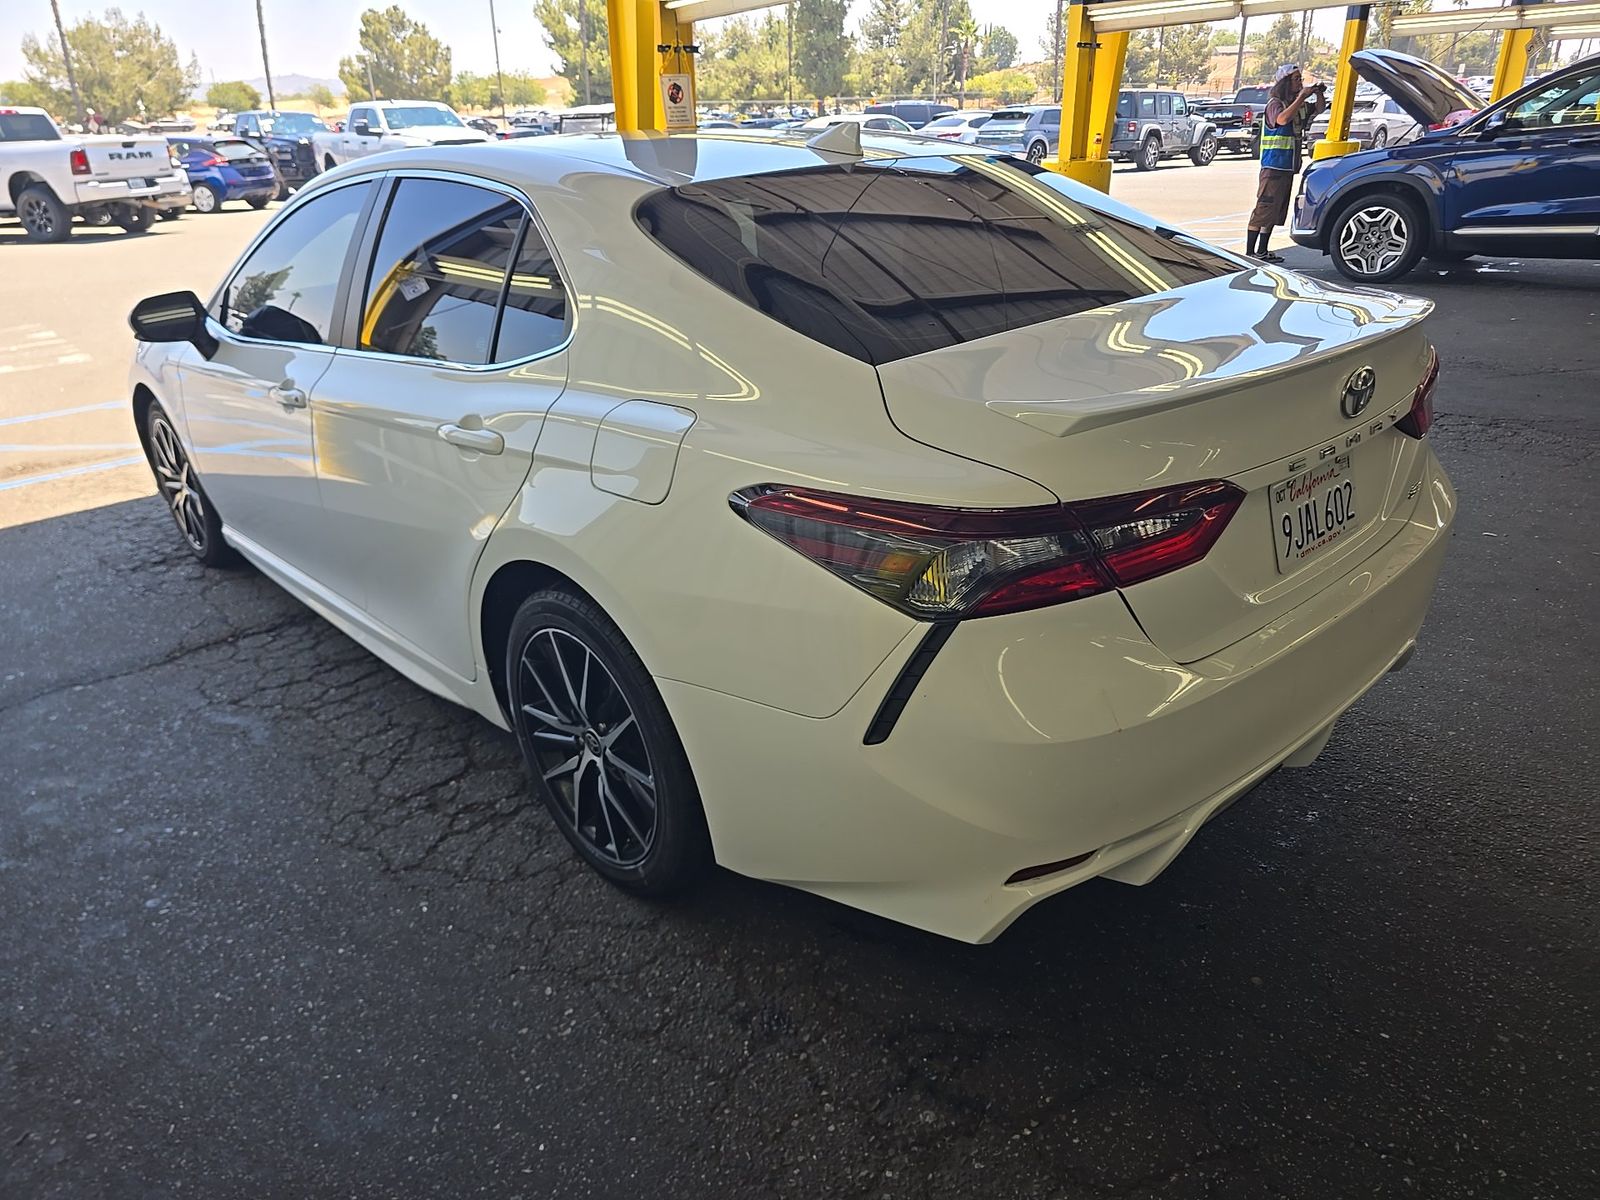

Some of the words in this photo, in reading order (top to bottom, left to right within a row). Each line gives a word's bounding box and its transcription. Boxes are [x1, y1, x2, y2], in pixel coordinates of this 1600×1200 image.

[108, 151, 153, 160] RAM
[1288, 409, 1398, 472] CAMRY
[1275, 489, 1286, 503] OCT
[1289, 466, 1341, 502] California
[1282, 480, 1355, 558] 9JAL602
[1300, 529, 1341, 558] dmv.ca.gov
